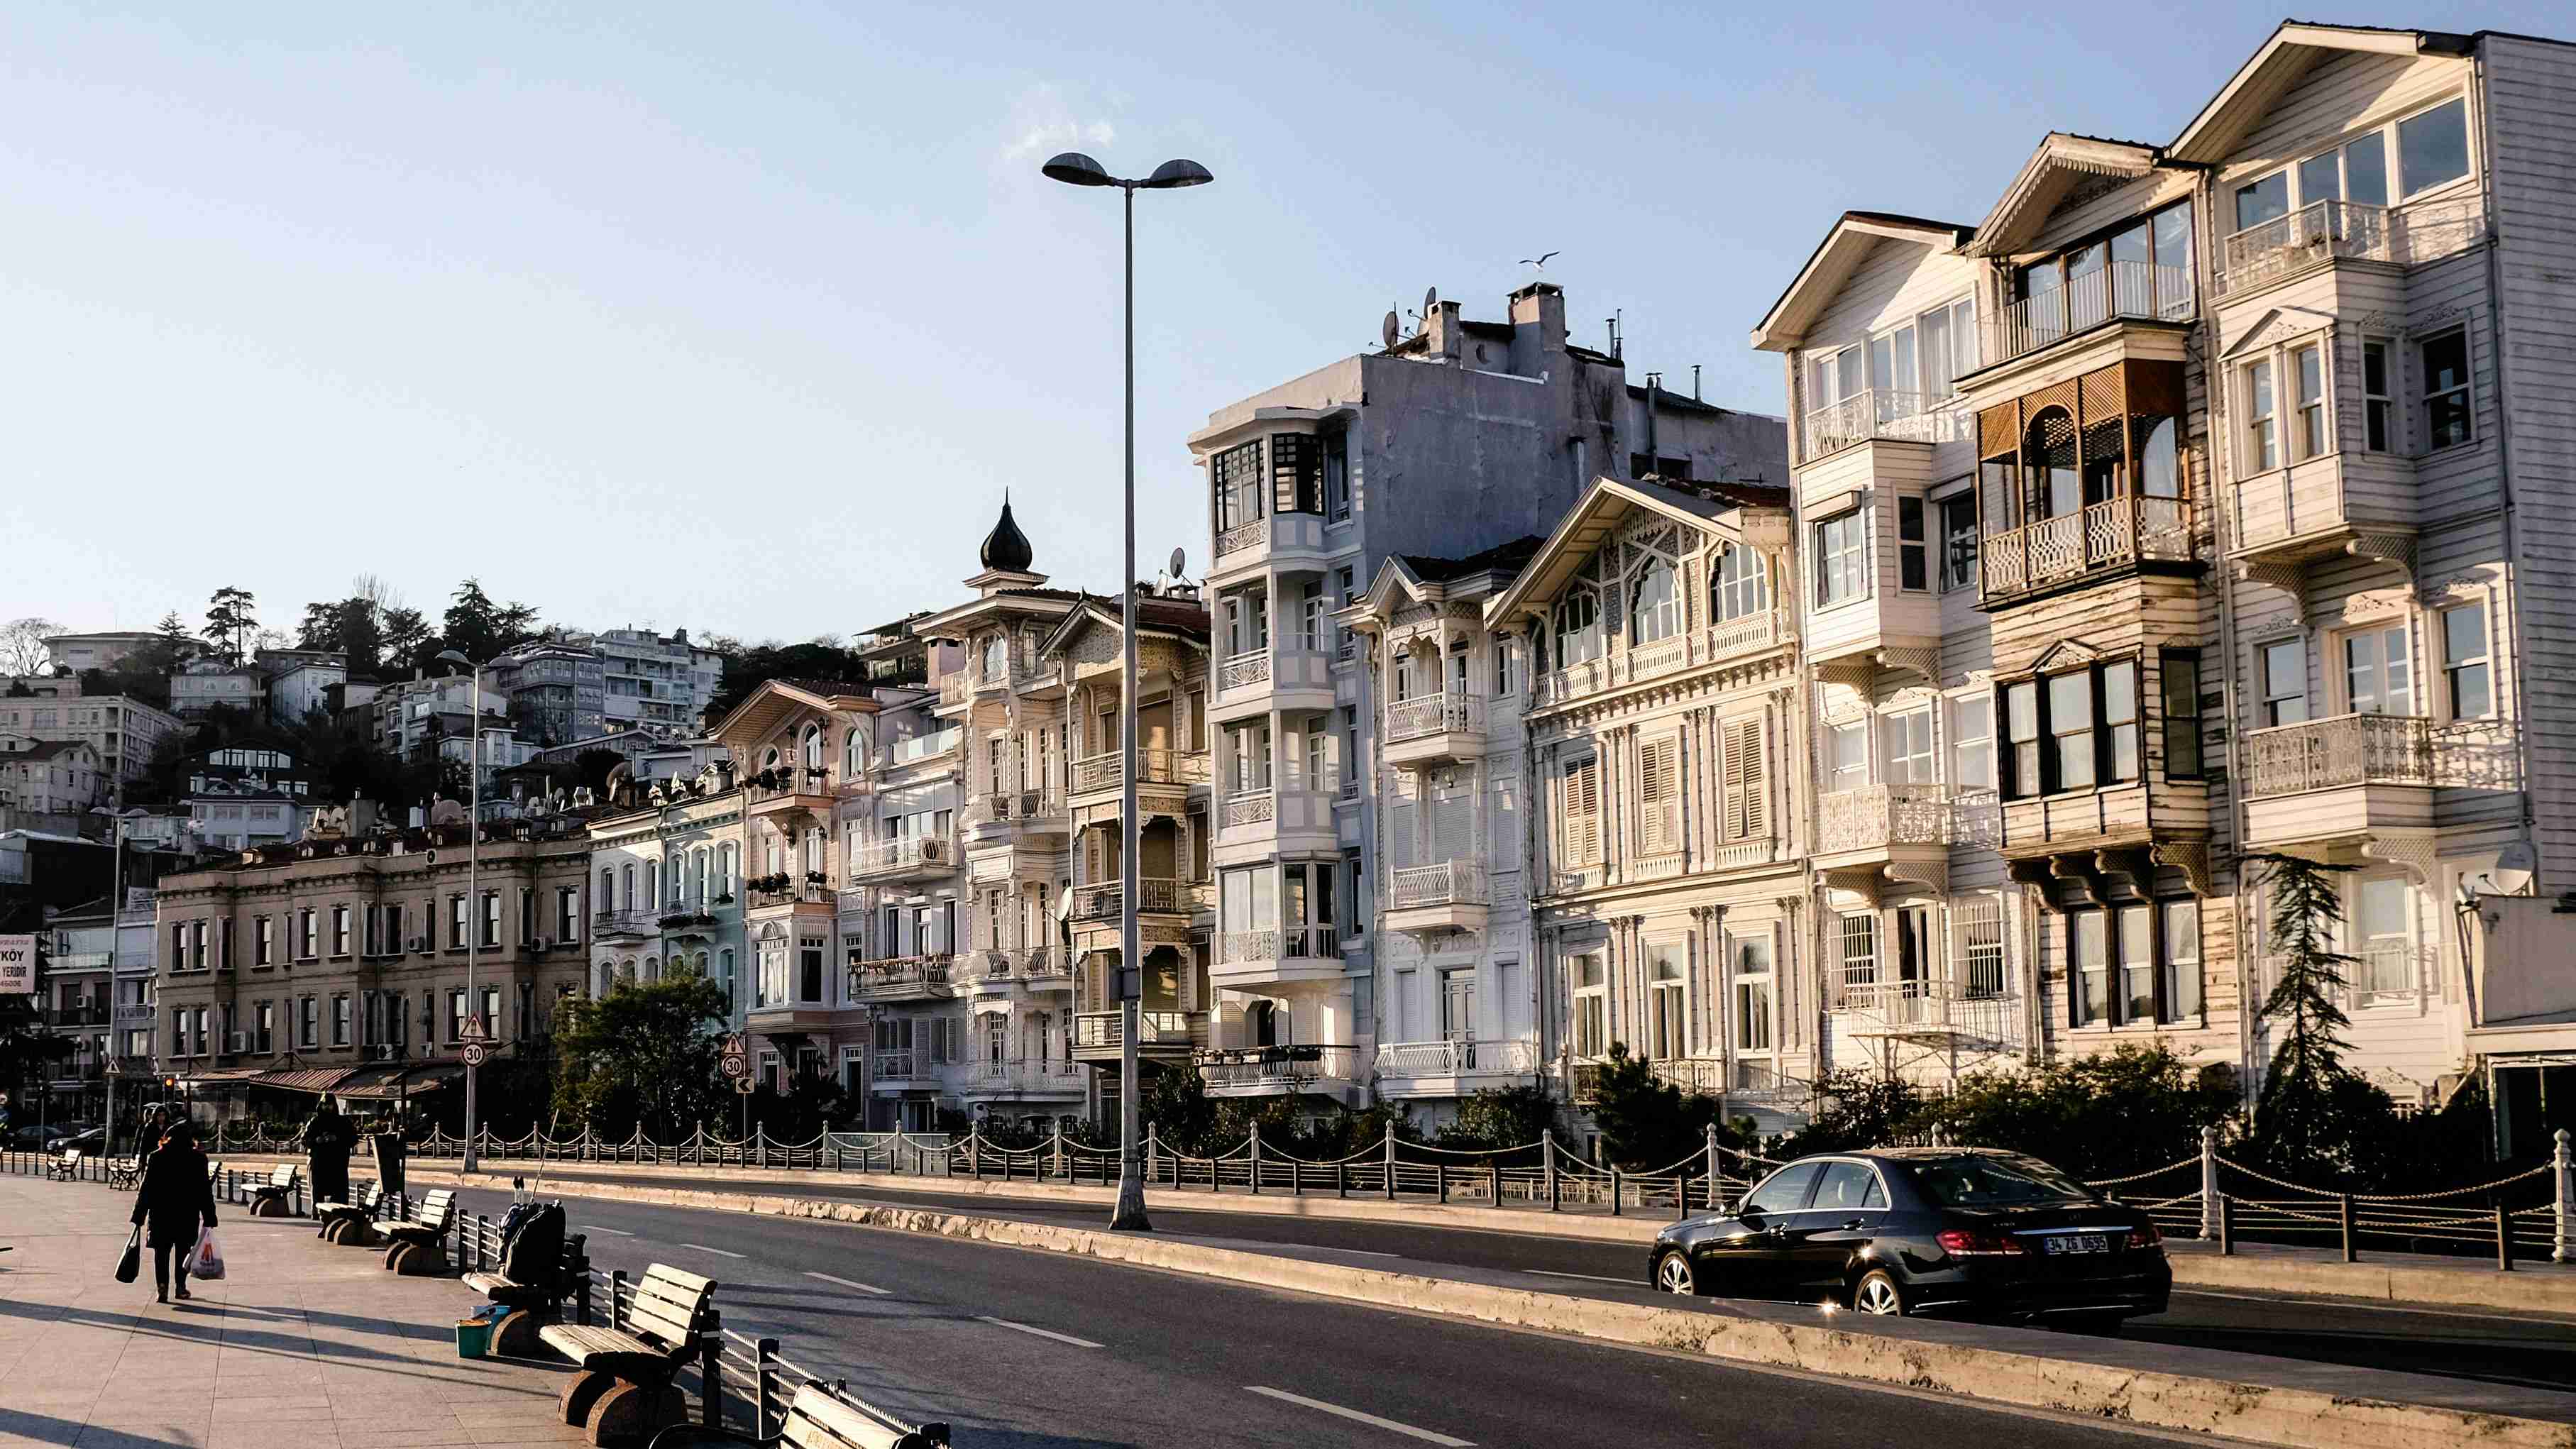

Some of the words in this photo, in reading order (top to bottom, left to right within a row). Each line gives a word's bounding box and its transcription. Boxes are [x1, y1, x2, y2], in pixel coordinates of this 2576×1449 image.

[0, 948, 23, 962] KÖY
[466, 1048, 480, 1060] 30
[727, 1061, 740, 1072] 30
[2049, 1238, 2062, 1250] 34
[2066, 1238, 2078, 1249] ZG
